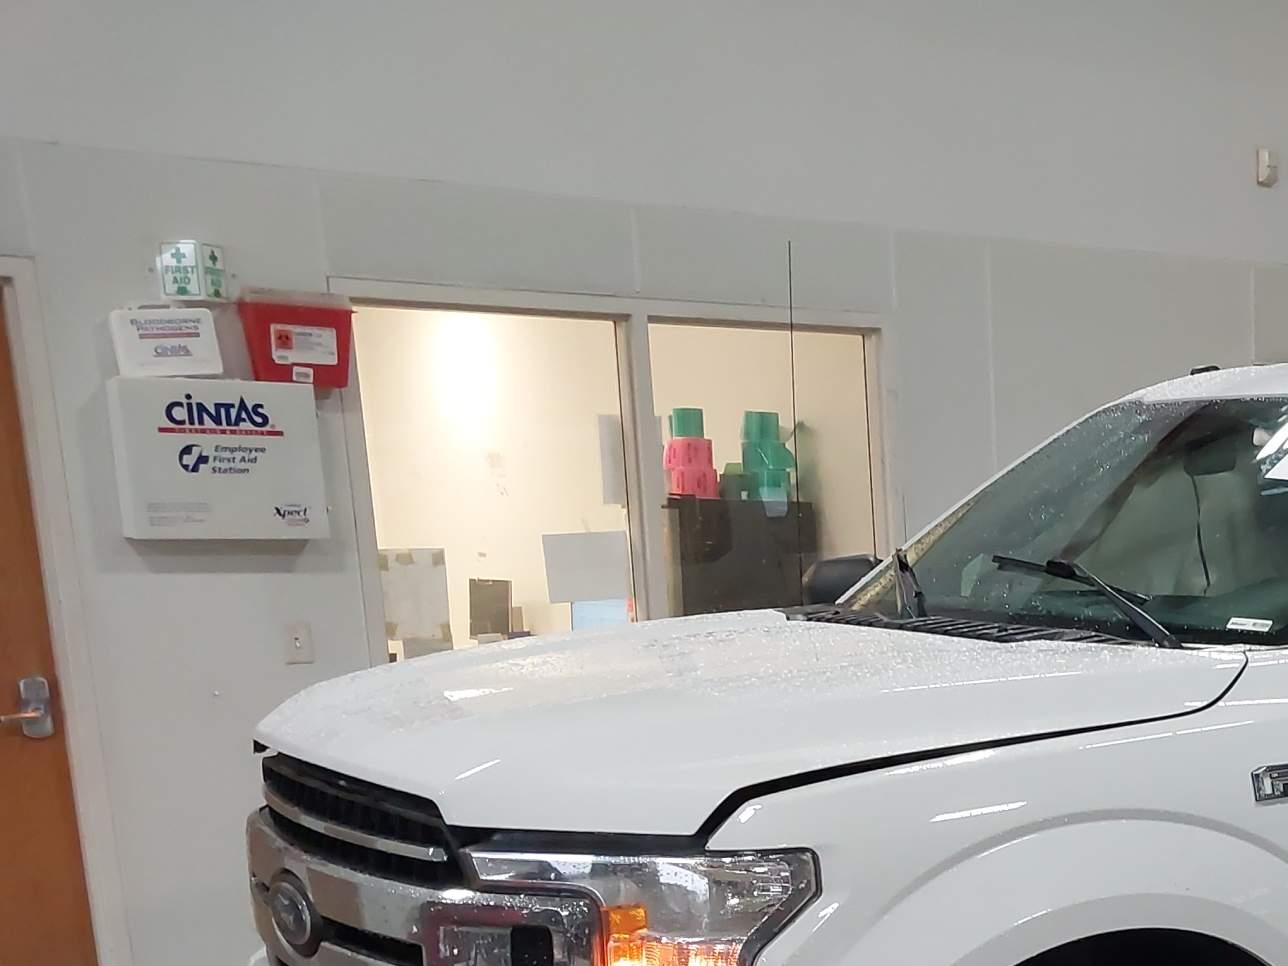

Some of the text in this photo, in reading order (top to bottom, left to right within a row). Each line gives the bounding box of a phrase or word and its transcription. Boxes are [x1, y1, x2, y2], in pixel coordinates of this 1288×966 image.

[164, 265, 195, 275] FIRST
[172, 276, 191, 285] AID
[214, 445, 266, 455] Employee
[212, 455, 257, 464] First Aid
[211, 466, 250, 474] Station
